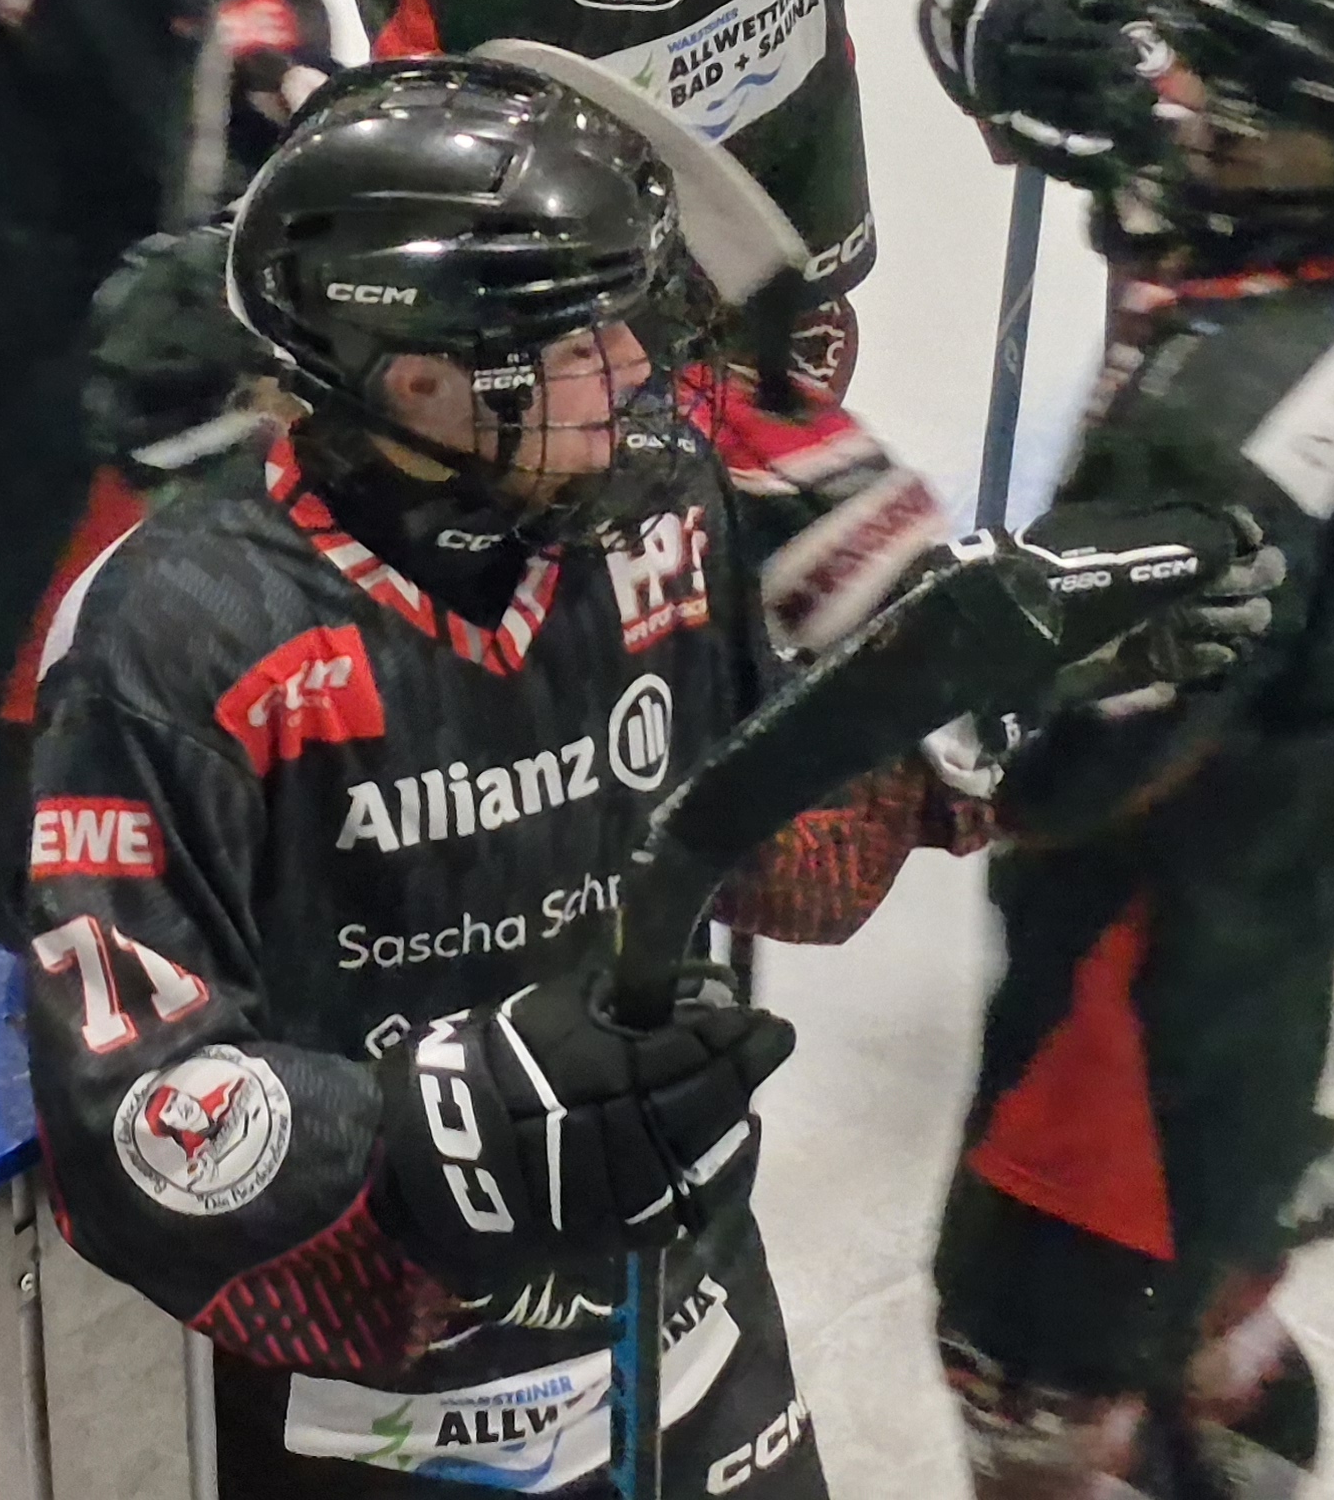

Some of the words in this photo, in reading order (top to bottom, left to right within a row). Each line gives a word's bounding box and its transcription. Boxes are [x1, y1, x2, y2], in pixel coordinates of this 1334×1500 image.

[670, 62, 724, 109] BAD
[326, 282, 418, 306] CCM
[473, 372, 536, 393] CCM
[1130, 556, 1198, 582] CCM
[335, 734, 601, 854] Allianz
[30, 809, 154, 866] EWE
[337, 911, 528, 972] Sascha
[416, 1008, 515, 1233] CCM
